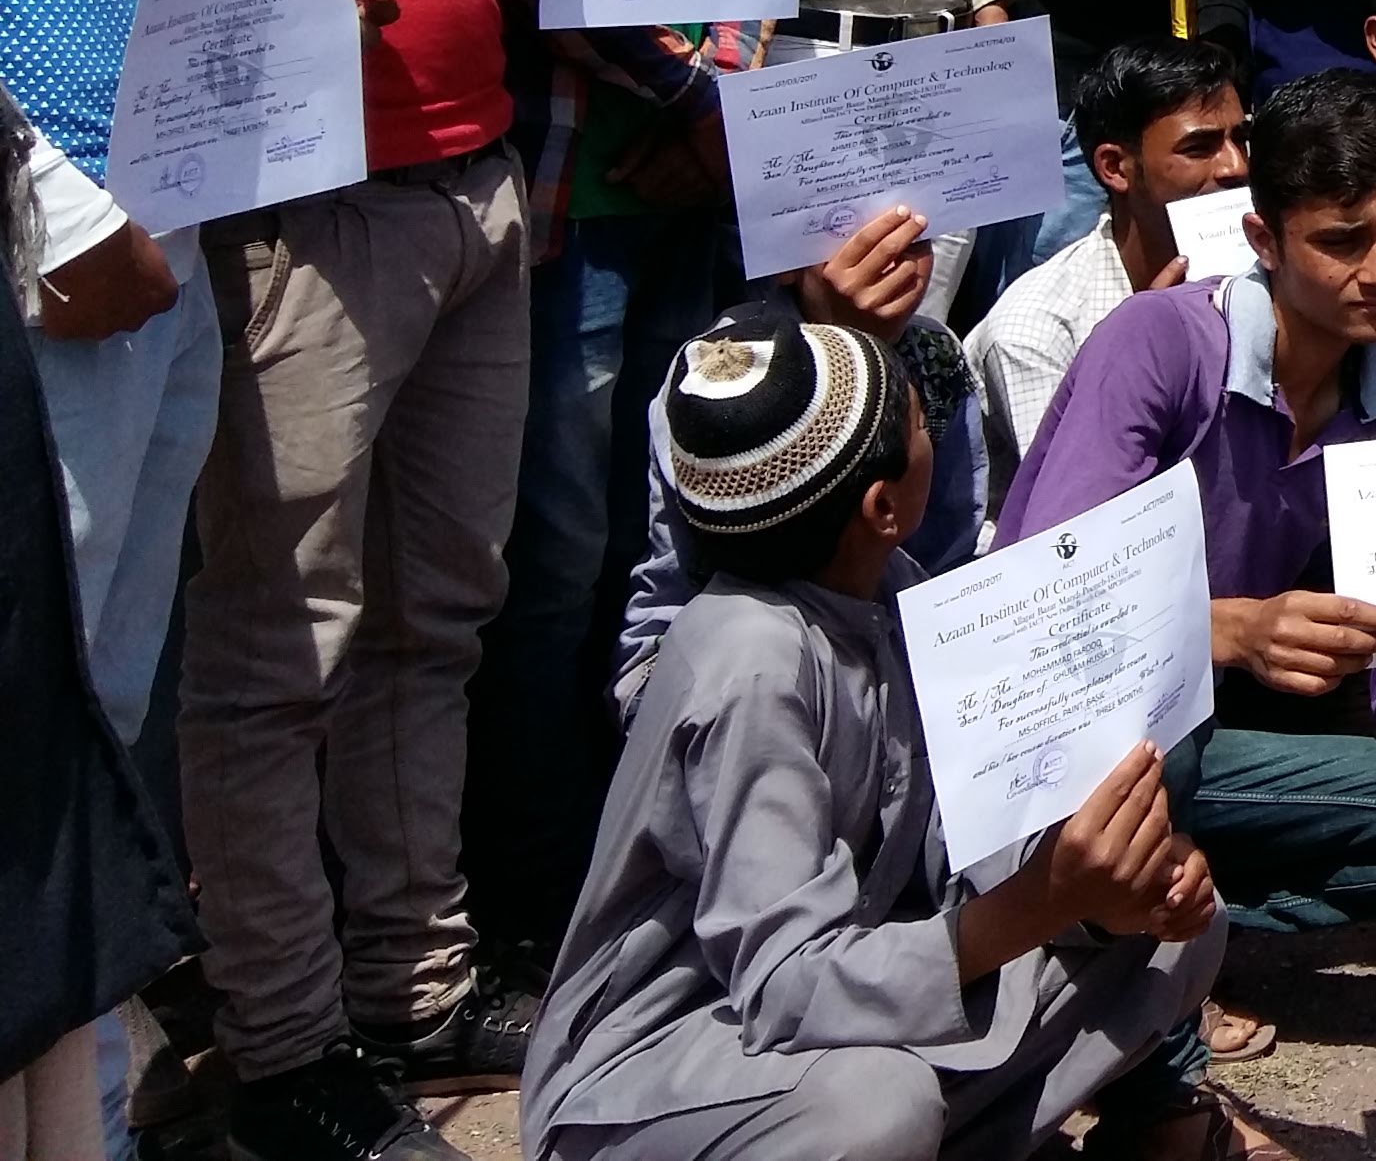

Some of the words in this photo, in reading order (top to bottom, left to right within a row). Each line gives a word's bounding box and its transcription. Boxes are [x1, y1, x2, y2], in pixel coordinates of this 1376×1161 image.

[747, 106, 786, 120] Azaan
[790, 95, 840, 112] Institute
[843, 87, 860, 100] Of
[864, 77, 924, 96] Computer
[928, 72, 939, 82] &
[944, 60, 1015, 80] Technology
[854, 106, 921, 125] Certificate
[933, 622, 975, 648] Azaan
[980, 599, 1029, 628] Institute
[1033, 585, 1049, 603] Of
[1053, 560, 1109, 595] Computer
[1112, 552, 1120, 567] &
[1123, 524, 1177, 560] Technology
[1048, 601, 1111, 637] Certificate
[1022, 652, 1072, 681] MOHAMMAD
[1073, 638, 1102, 658] FAROOQ
